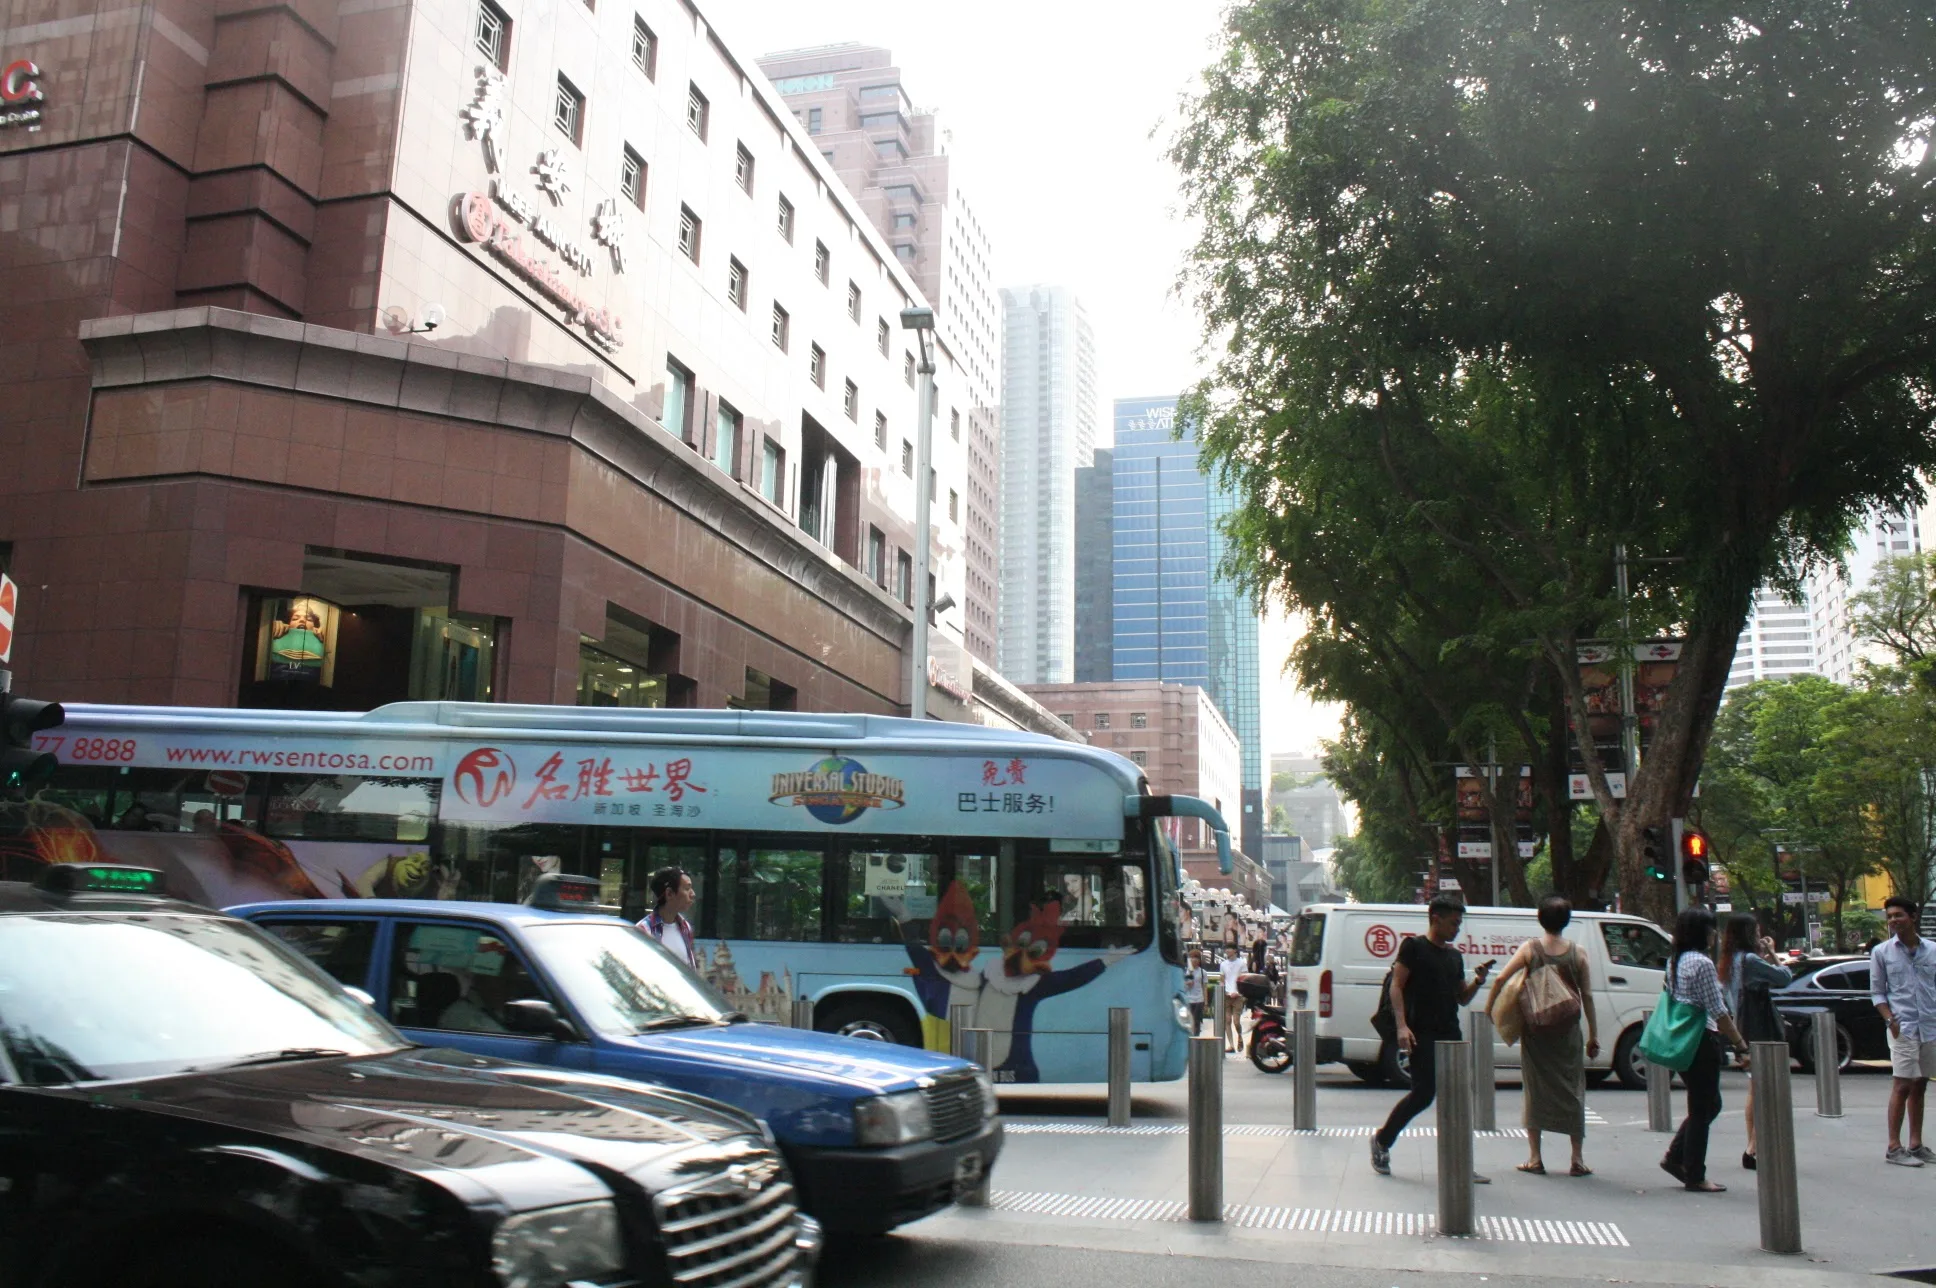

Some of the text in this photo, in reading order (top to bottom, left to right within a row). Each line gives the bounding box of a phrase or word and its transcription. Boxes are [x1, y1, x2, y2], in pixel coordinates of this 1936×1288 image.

[497, 178, 535, 226] NGEE
[563, 240, 598, 278] CITY
[71, 737, 137, 762] 8888
[166, 746, 434, 772] www.rwsentosa.com
[771, 771, 905, 800] UNIVERSAL STUDIOS
